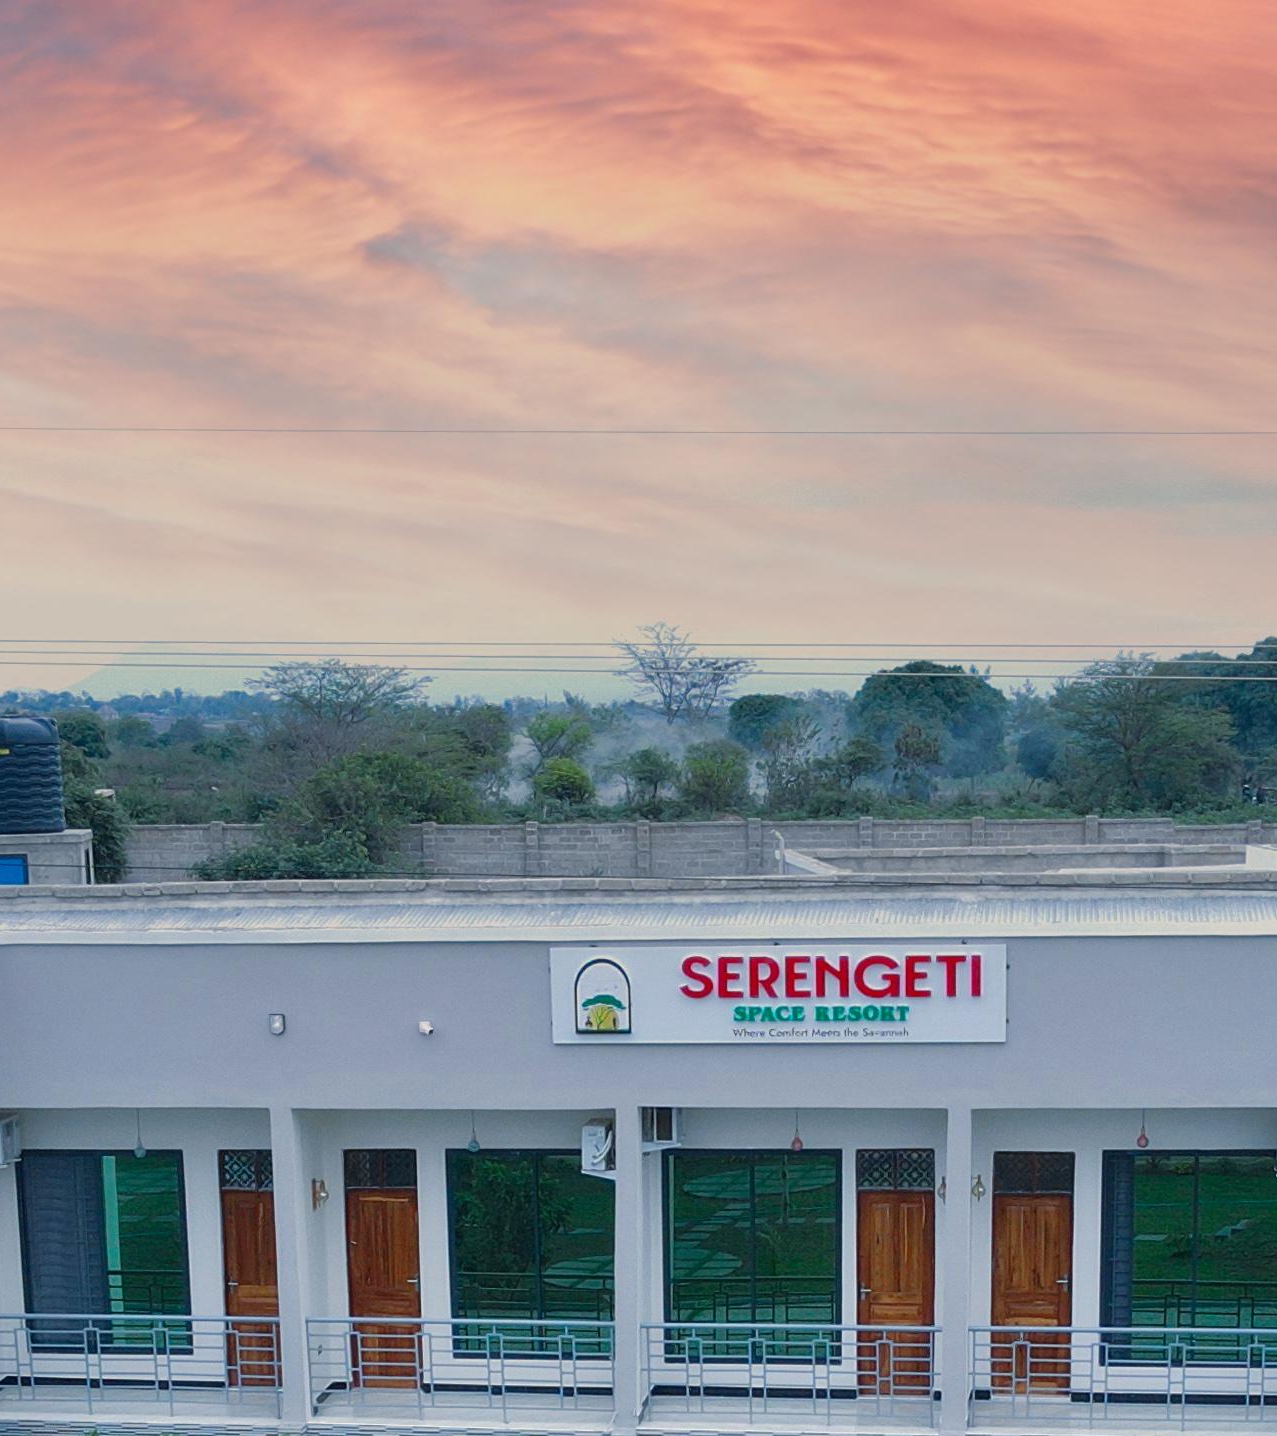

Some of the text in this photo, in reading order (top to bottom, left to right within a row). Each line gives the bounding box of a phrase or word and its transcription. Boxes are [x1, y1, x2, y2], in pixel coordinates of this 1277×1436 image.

[680, 954, 981, 999] SERENGETI
[733, 1004, 910, 1022] SPACE RESORT
[733, 1028, 765, 1038] Where
[768, 1027, 808, 1038] Comfort
[844, 1027, 859, 1038] the
